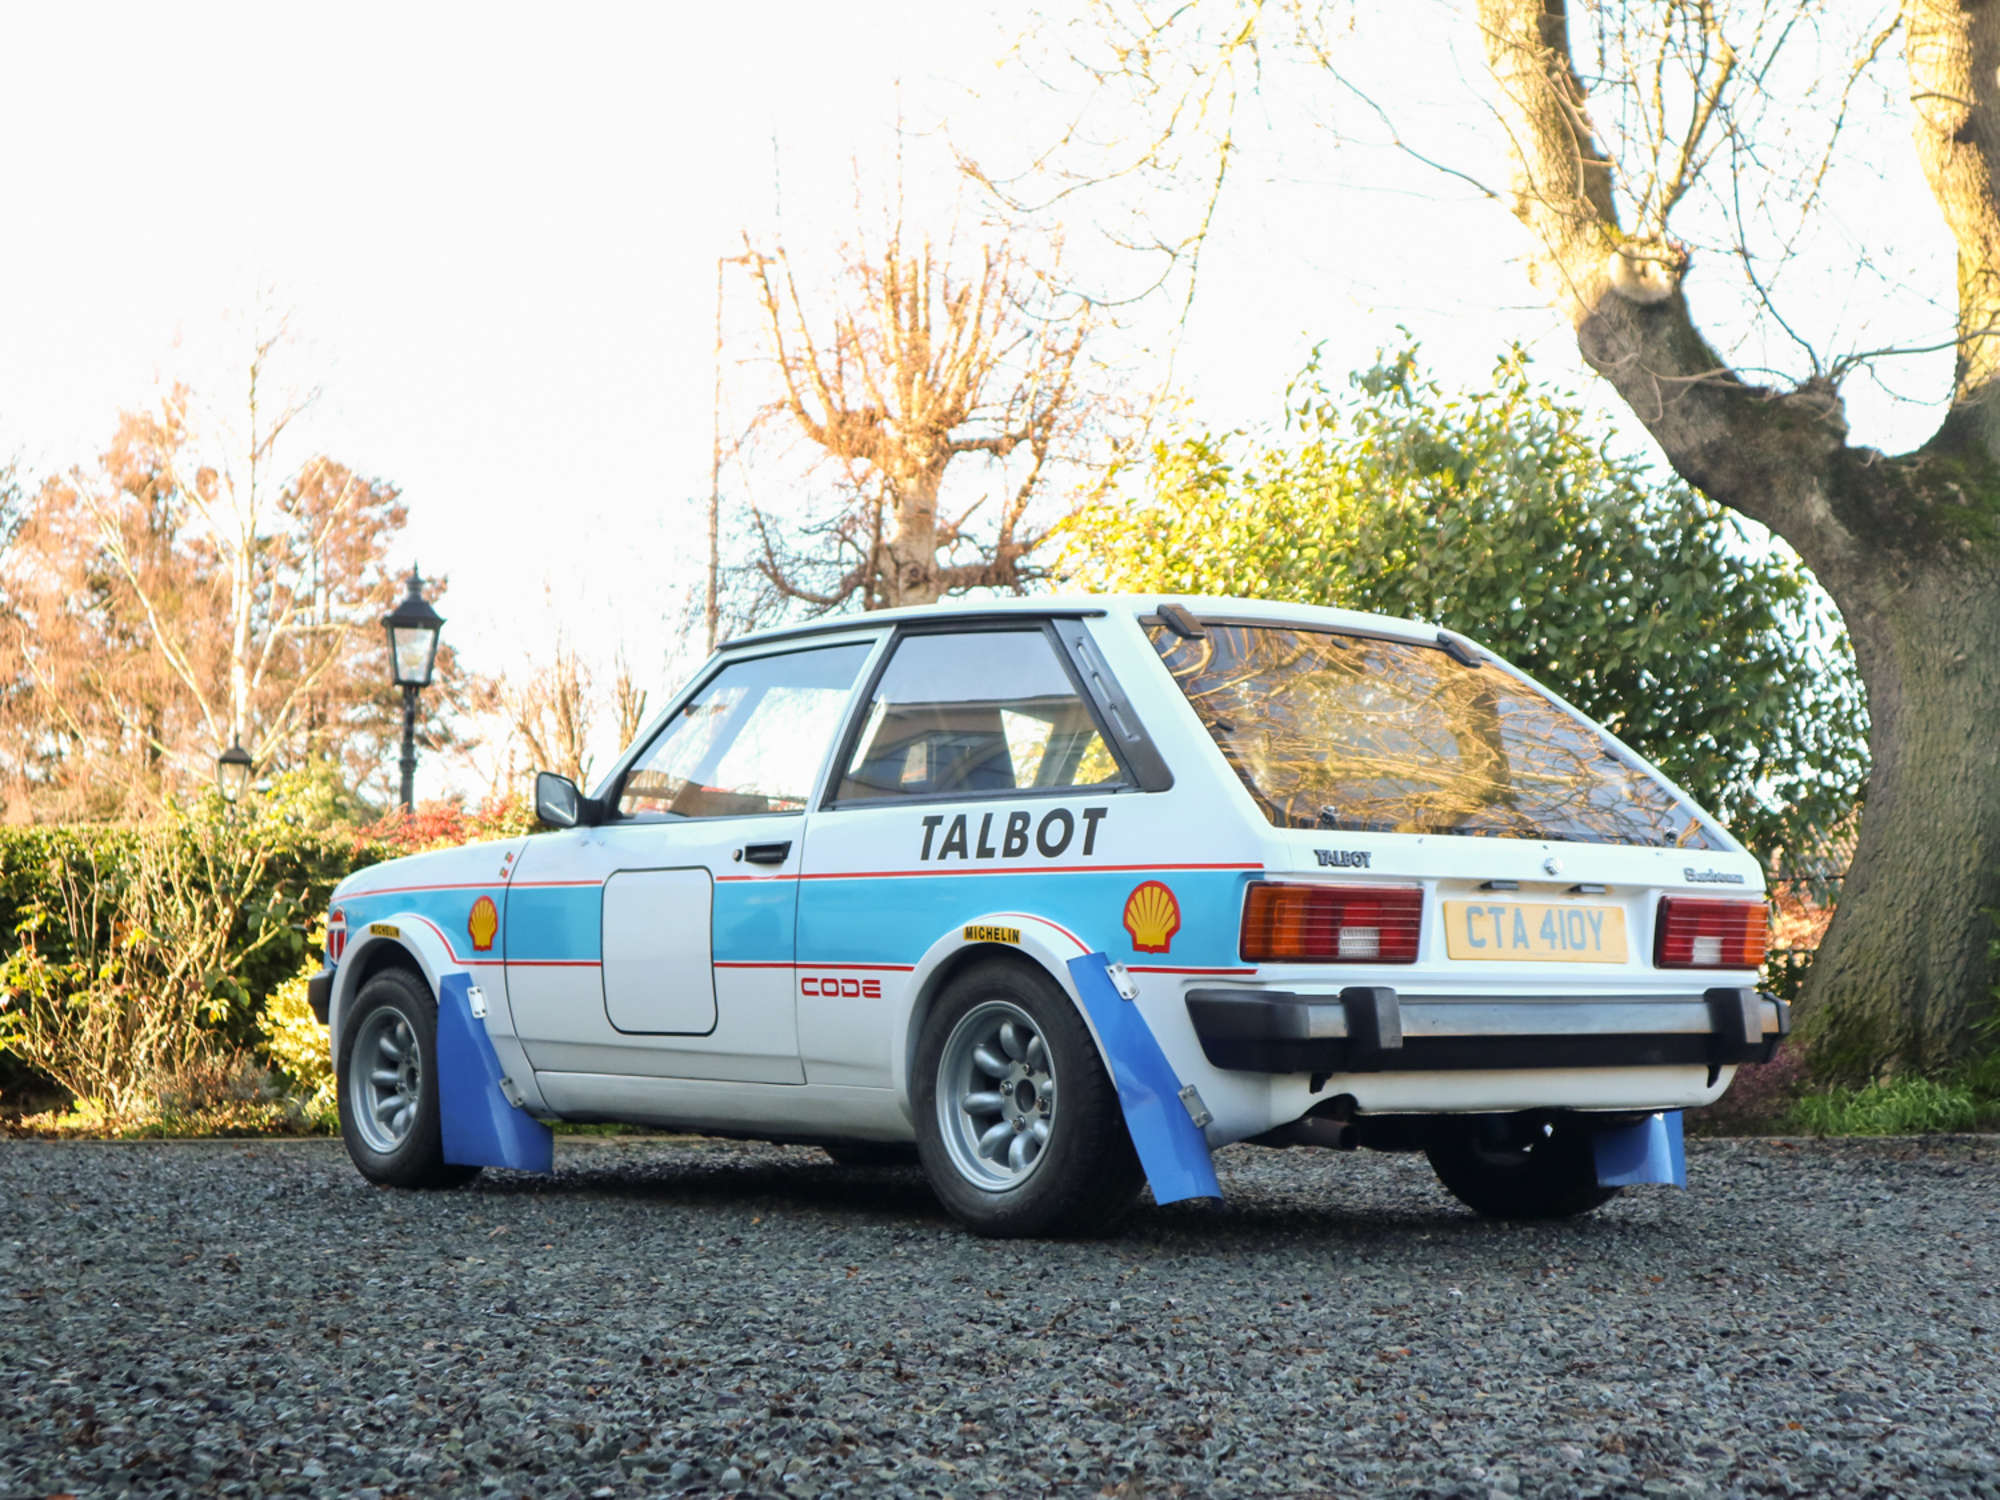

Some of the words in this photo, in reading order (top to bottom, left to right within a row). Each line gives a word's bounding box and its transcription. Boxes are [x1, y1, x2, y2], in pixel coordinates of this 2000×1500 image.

[920, 807, 1109, 861] TALBOT
[1313, 849, 1372, 869] TALBOT
[964, 926, 1021, 943] MICHELIN
[1465, 905, 1530, 950] CTA
[1539, 908, 1604, 952] 410Y
[801, 977, 882, 999] CODE
